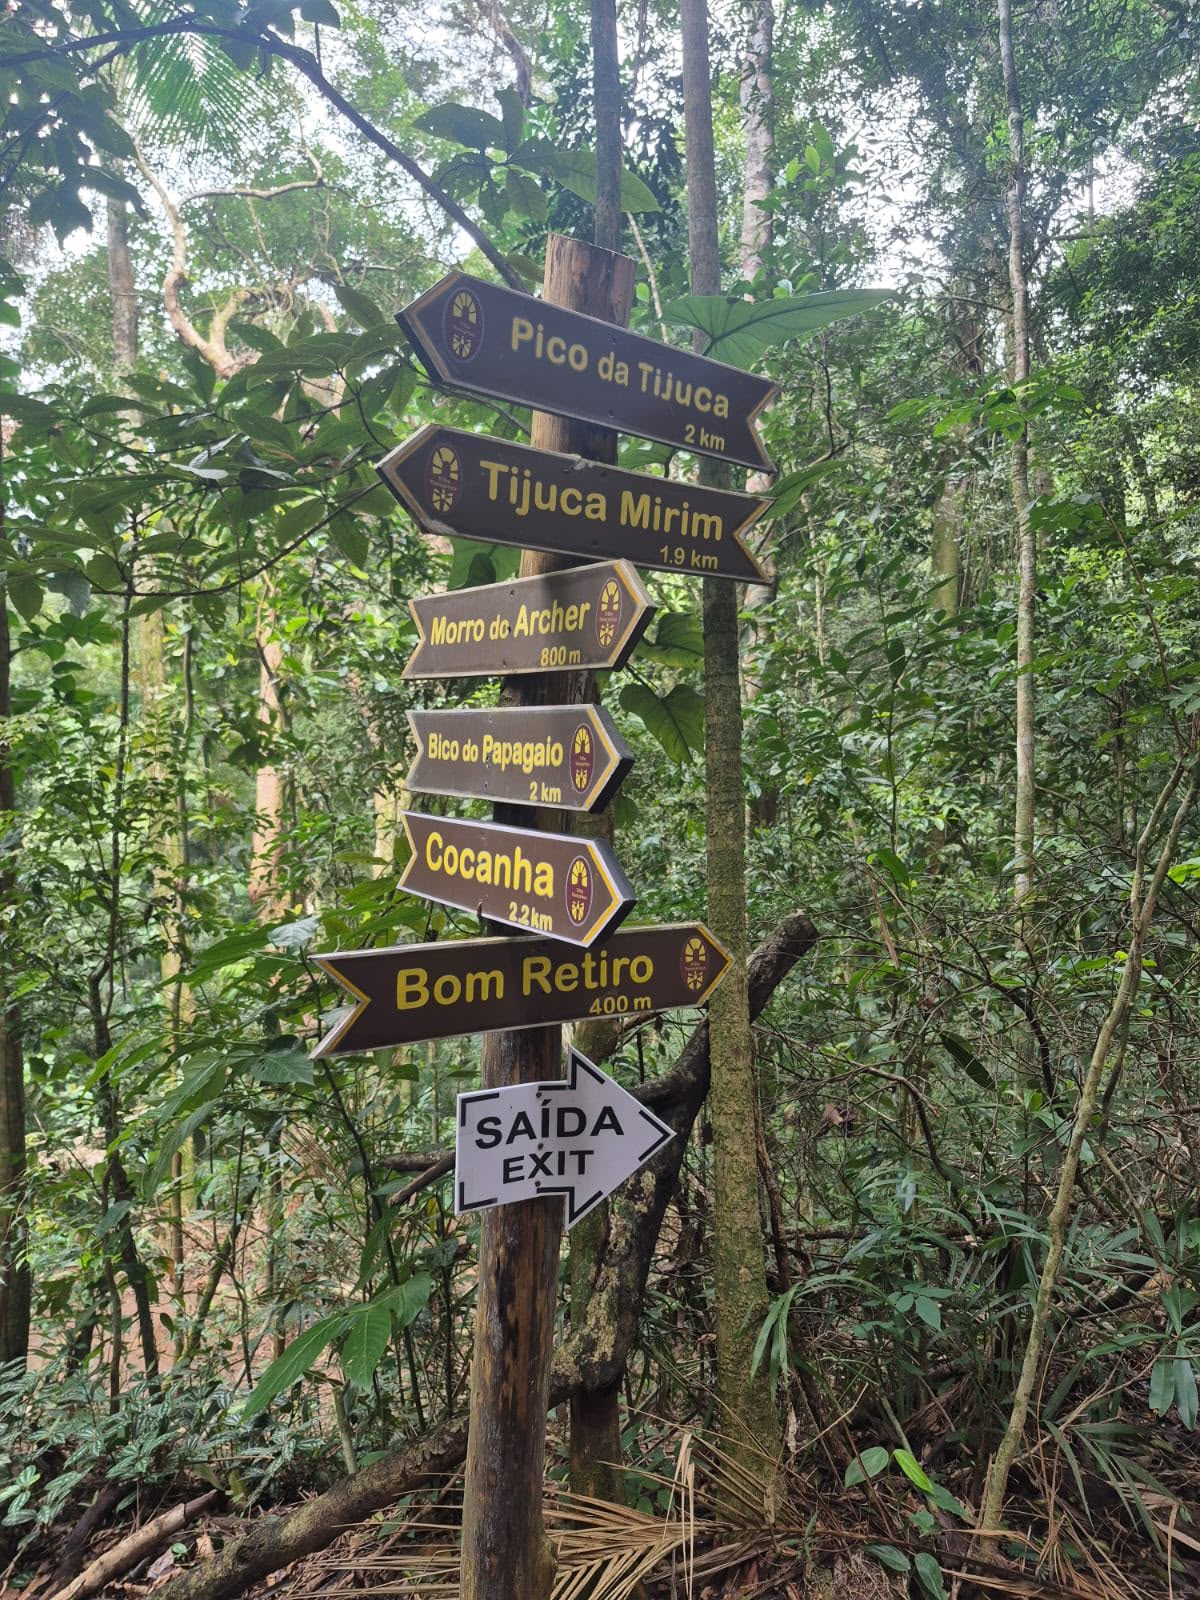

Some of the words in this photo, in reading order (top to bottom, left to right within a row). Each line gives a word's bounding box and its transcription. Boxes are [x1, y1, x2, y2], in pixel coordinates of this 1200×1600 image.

[511, 317, 588, 372] Pico
[598, 352, 629, 387] da
[639, 362, 729, 419] Tijuca
[684, 426, 696, 444] 2
[700, 427, 725, 452] km
[480, 460, 607, 521] Tijuca
[620, 489, 723, 541] Mirim
[660, 546, 686, 565] 1.9
[691, 549, 718, 569] km
[431, 616, 484, 646] Morro
[490, 614, 509, 640] do
[514, 600, 590, 638] Archer
[540, 647, 566, 666] 800
[569, 648, 580, 665] m
[428, 733, 459, 761] Bico
[462, 739, 478, 762] do
[482, 734, 563, 774] Papagaio
[529, 781, 538, 801] 2
[541, 782, 561, 803] km
[426, 832, 554, 898] Cocanha
[396, 967, 504, 1010] Bom
[522, 951, 654, 997] Retiro
[588, 995, 628, 1016] 400
[634, 995, 651, 1010] m
[475, 1099, 624, 1149] SAÍDA
[503, 1151, 594, 1184] EXIT
